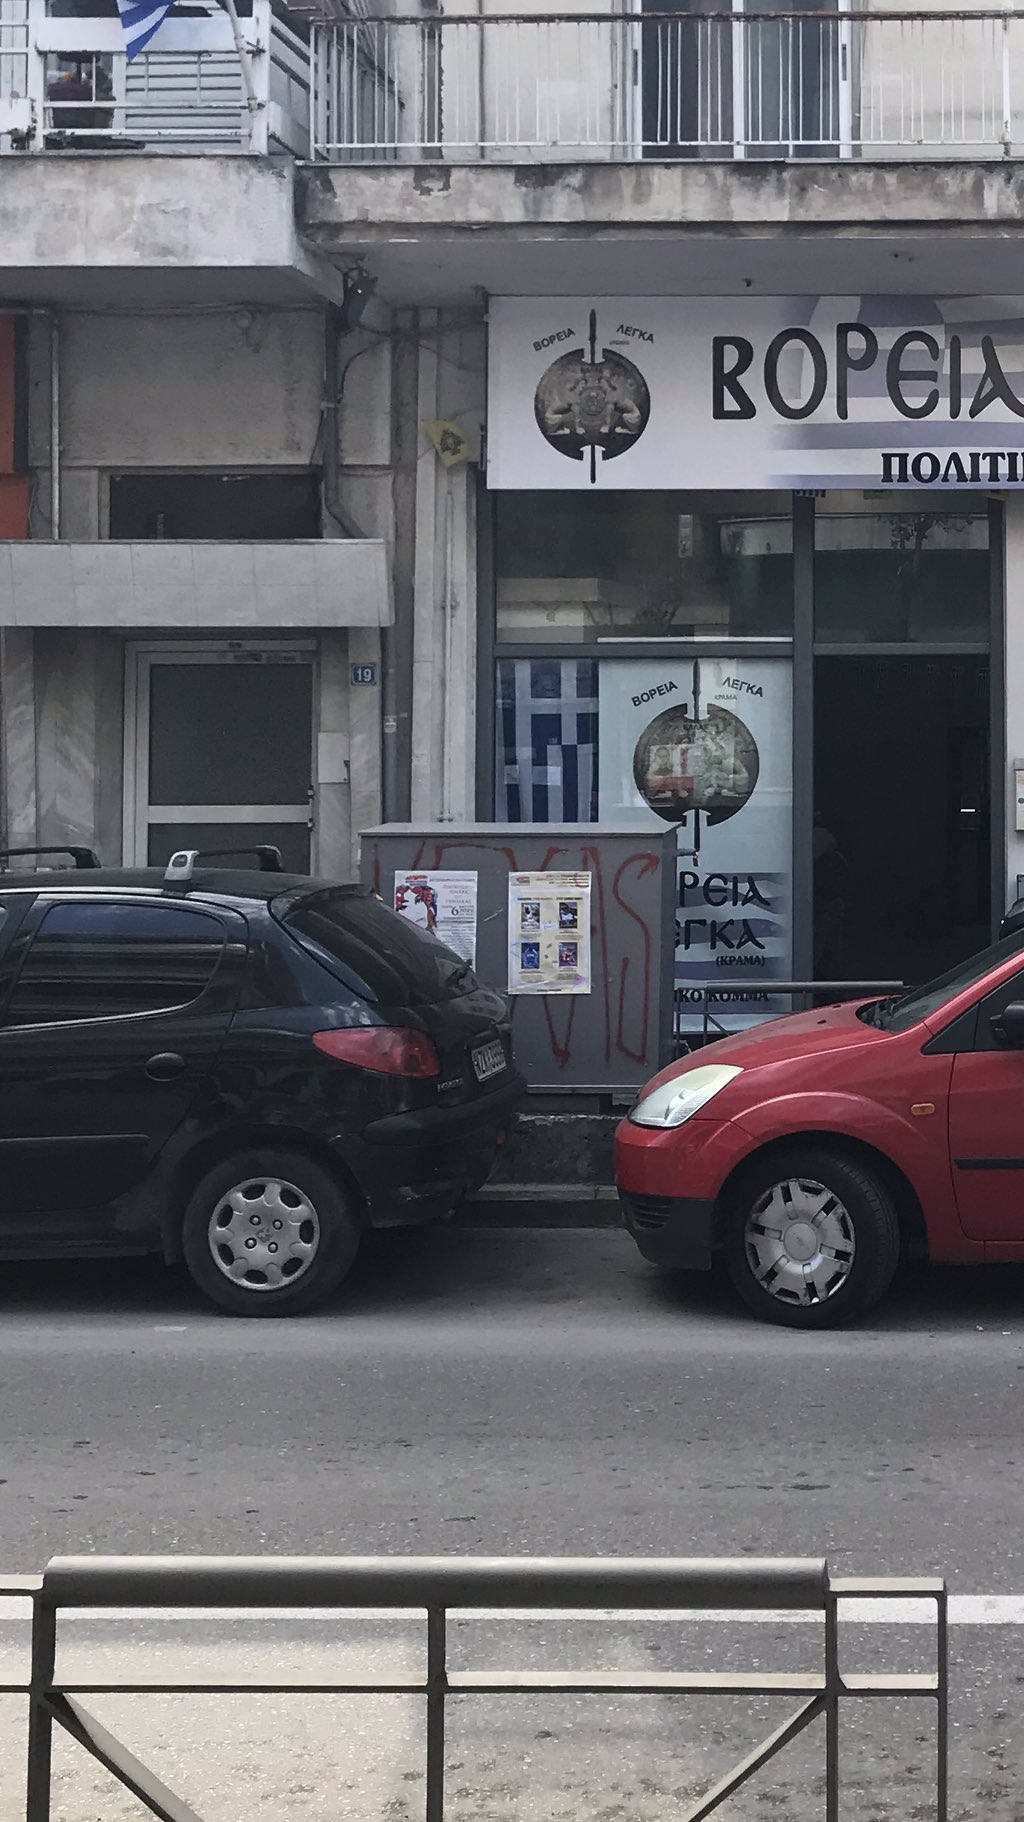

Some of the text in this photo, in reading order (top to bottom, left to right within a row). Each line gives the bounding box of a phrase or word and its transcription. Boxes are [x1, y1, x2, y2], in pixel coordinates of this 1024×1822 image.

[532, 324, 654, 352] ΒΟΡΕΙΑ ΛΕΓΚΑ
[356, 667, 372, 682] 19
[631, 676, 764, 708] ΒΟΡΕΙΑ ΛΕΓΚΑ
[679, 871, 771, 907] ΡΕΙΑ
[675, 918, 766, 950] ΓΚΑ
[715, 955, 766, 968] (ΚΡΑΜΑ)
